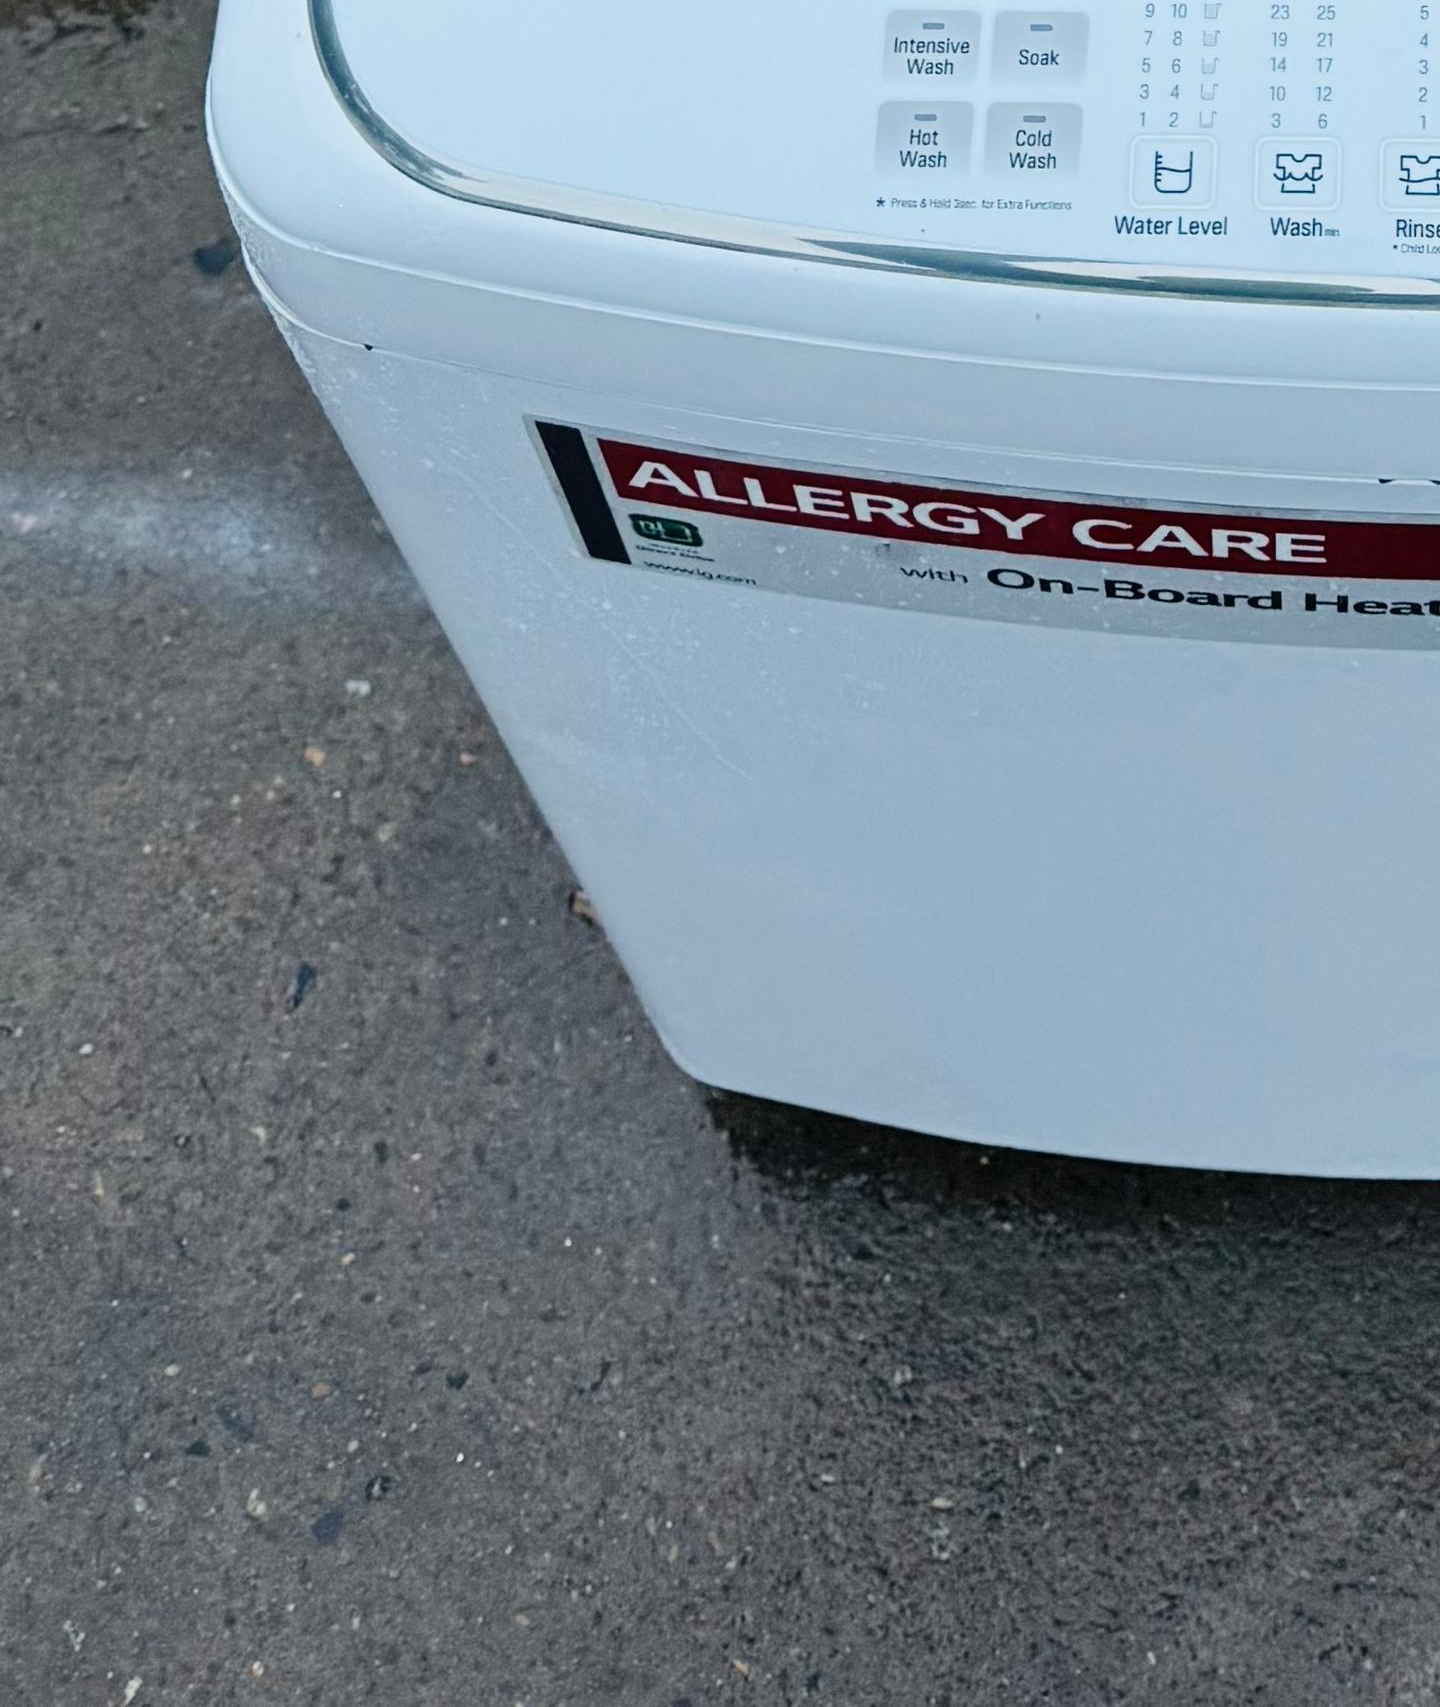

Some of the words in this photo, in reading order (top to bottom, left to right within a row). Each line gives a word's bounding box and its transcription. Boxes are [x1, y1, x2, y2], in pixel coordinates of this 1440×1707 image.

[1144, 2, 1156, 19] 9
[1171, 3, 1188, 19] 10
[1270, 3, 1290, 20] 23
[1316, 4, 1336, 21] 25
[1419, 4, 1430, 21] 5
[893, 36, 970, 55] Intensive
[1143, 30, 1153, 46] 7
[1172, 30, 1183, 47] 8
[1271, 31, 1288, 48] 19
[1316, 31, 1334, 48] 21
[1419, 32, 1429, 48] 4
[1018, 48, 1060, 66] Soak
[1141, 57, 1152, 74] 5
[1171, 57, 1182, 75] 6
[1269, 56, 1287, 73] 14
[1316, 57, 1334, 74] 17
[906, 57, 954, 76] Wash
[1418, 58, 1430, 76] 3
[1138, 83, 1150, 100] 3
[1169, 83, 1180, 100] 4
[1268, 85, 1287, 102] 10
[1315, 85, 1333, 103] 12
[1418, 86, 1429, 103] 2
[1139, 111, 1146, 128] 1
[1168, 111, 1180, 128] 2
[1270, 112, 1282, 129] 3
[1317, 112, 1328, 130] 6
[1419, 114, 1427, 131] 1
[909, 128, 939, 147] Hot
[1015, 129, 1053, 148] Cold
[899, 149, 948, 168] Wash
[1008, 151, 1057, 170] Wash
[997, 199, 1023, 210] Extra
[1114, 215, 1174, 236] Water
[1177, 215, 1228, 236] Level
[1270, 217, 1323, 237] Wash
[628, 461, 1045, 541] ALLERGY
[1072, 517, 1327, 563] CARE
[900, 565, 969, 586] with
[986, 567, 1284, 611] On-Board
